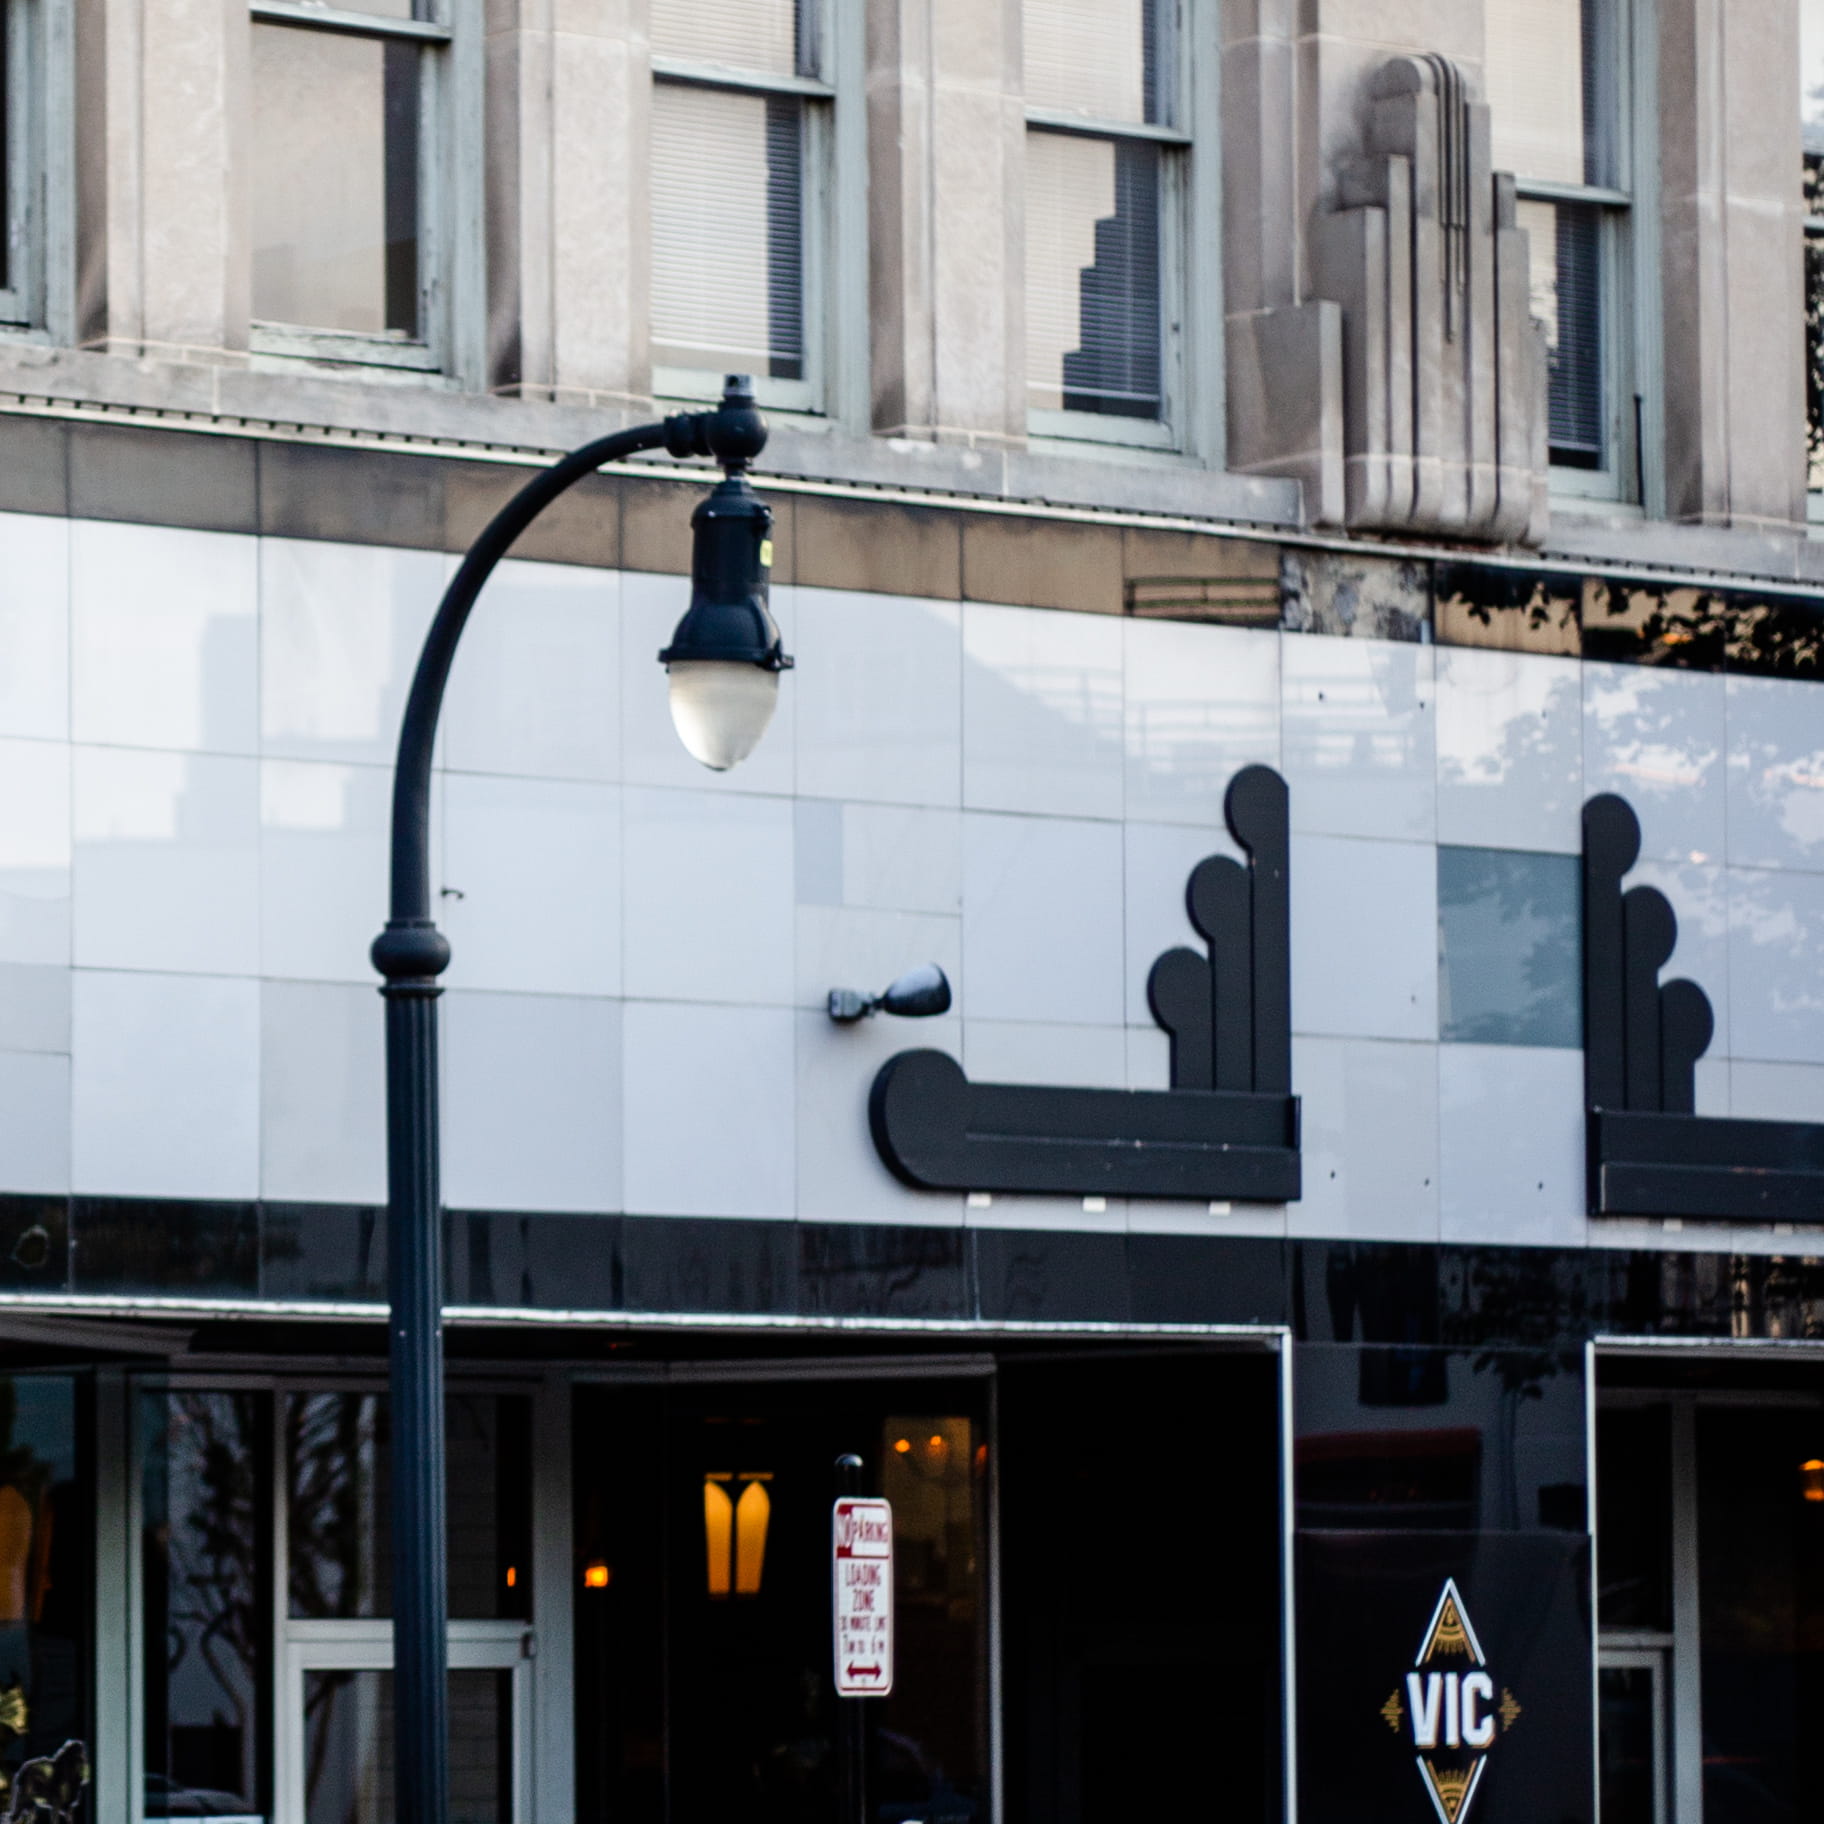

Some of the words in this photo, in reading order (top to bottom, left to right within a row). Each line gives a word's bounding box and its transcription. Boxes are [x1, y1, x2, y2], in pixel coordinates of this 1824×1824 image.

[845, 1563, 881, 1586] LOADING
[852, 1589, 874, 1612] ZONE
[1406, 1671, 1496, 1749] VIC
